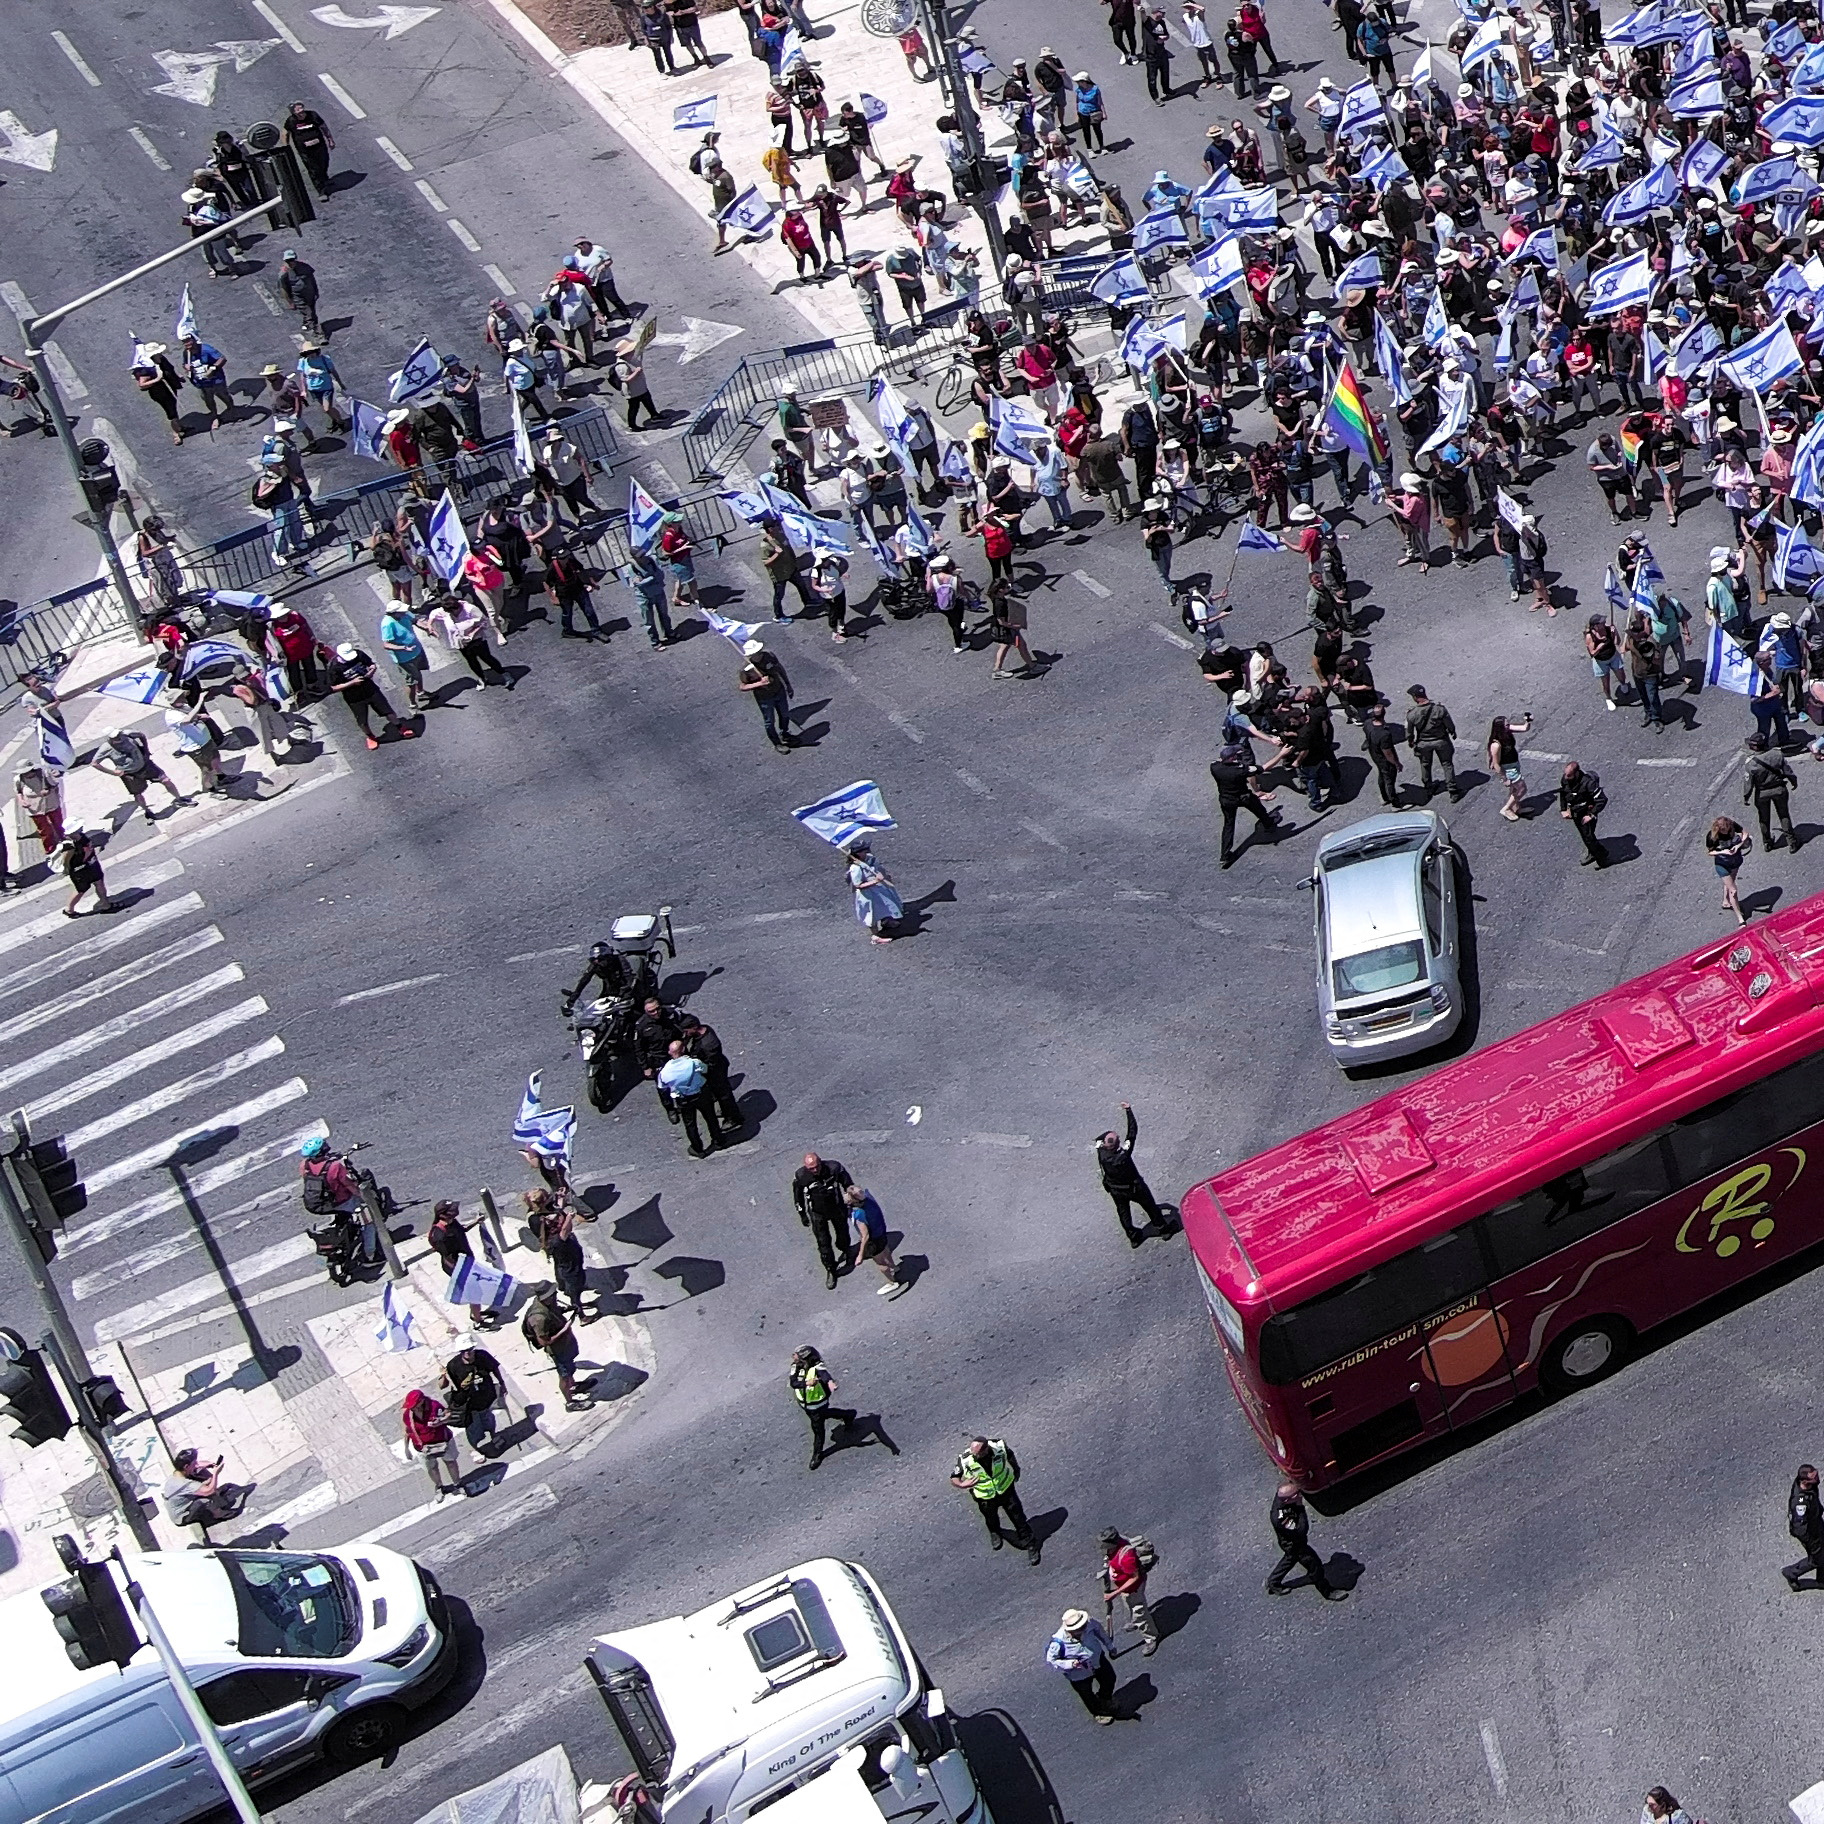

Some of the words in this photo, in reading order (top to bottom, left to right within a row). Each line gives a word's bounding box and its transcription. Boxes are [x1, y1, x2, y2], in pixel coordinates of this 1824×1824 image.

[768, 1754, 797, 1775] King
[799, 1740, 814, 1756] Of
[817, 1728, 841, 1745] The
[844, 1705, 876, 1730] Road
